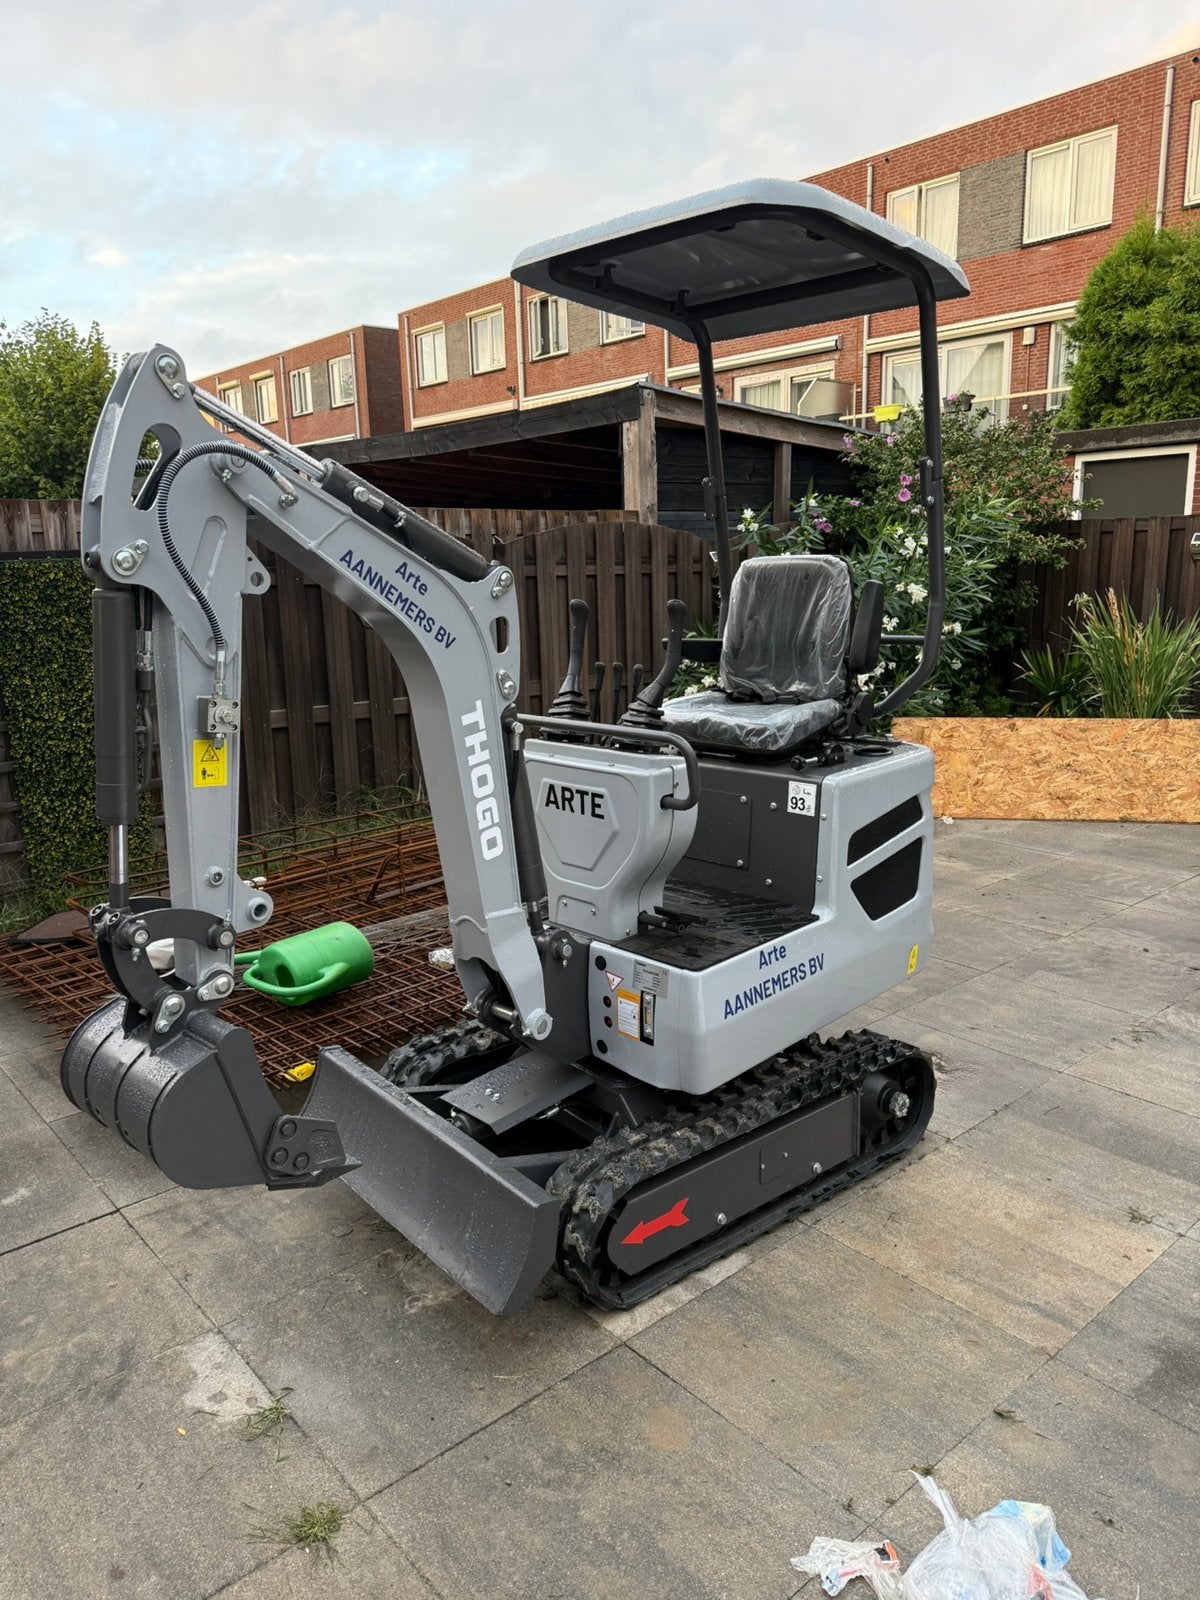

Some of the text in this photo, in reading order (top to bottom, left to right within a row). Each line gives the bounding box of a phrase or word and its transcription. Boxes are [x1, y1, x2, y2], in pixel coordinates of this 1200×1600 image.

[395, 562, 428, 595] Arte
[339, 549, 456, 649] AANNEMERS BV
[461, 700, 504, 861] THOGO
[545, 784, 605, 820] ARTE
[790, 796, 806, 811] 93
[759, 945, 787, 970] Arte
[724, 953, 824, 1020] AANNEMERS BV
